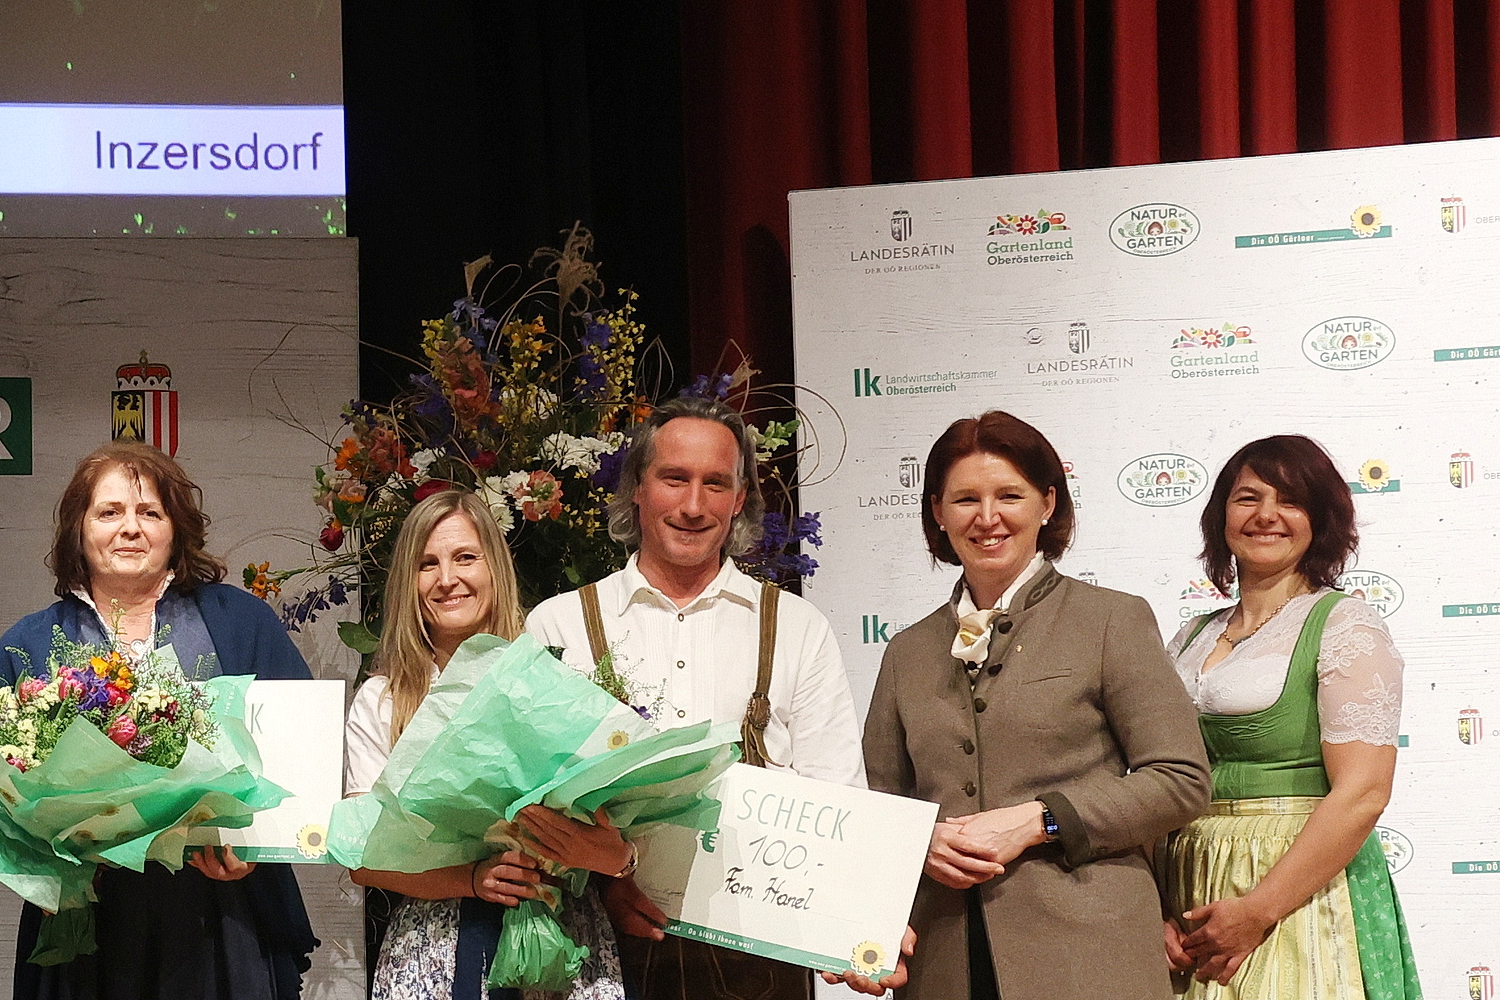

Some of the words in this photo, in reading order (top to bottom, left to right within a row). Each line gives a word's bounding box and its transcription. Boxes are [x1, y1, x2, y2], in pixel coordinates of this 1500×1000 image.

[96, 131, 323, 171] Inzersdorf
[1130, 208, 1178, 221] NATUR
[986, 236, 1074, 254] Gartenland
[1126, 235, 1184, 249] GARTEN
[850, 242, 955, 262] LANDESRÄTIN
[987, 251, 1074, 266] Oberösterreich
[1324, 321, 1372, 334] NATUR
[1170, 350, 1259, 367] Gartenland
[1320, 349, 1378, 363] GARTEN
[1027, 354, 1134, 374] LANDESRÄTIN
[886, 369, 998, 385] Landwirtschaftskammer
[1171, 365, 1260, 379] Oberösterreich
[886, 383, 957, 396] Oberösterreich
[1139, 458, 1186, 471] NATUR
[1134, 486, 1192, 499] GARTEN
[1341, 575, 1381, 587] ATUR
[736, 788, 852, 842] SCHECK
[723, 866, 754, 899] Fam.
